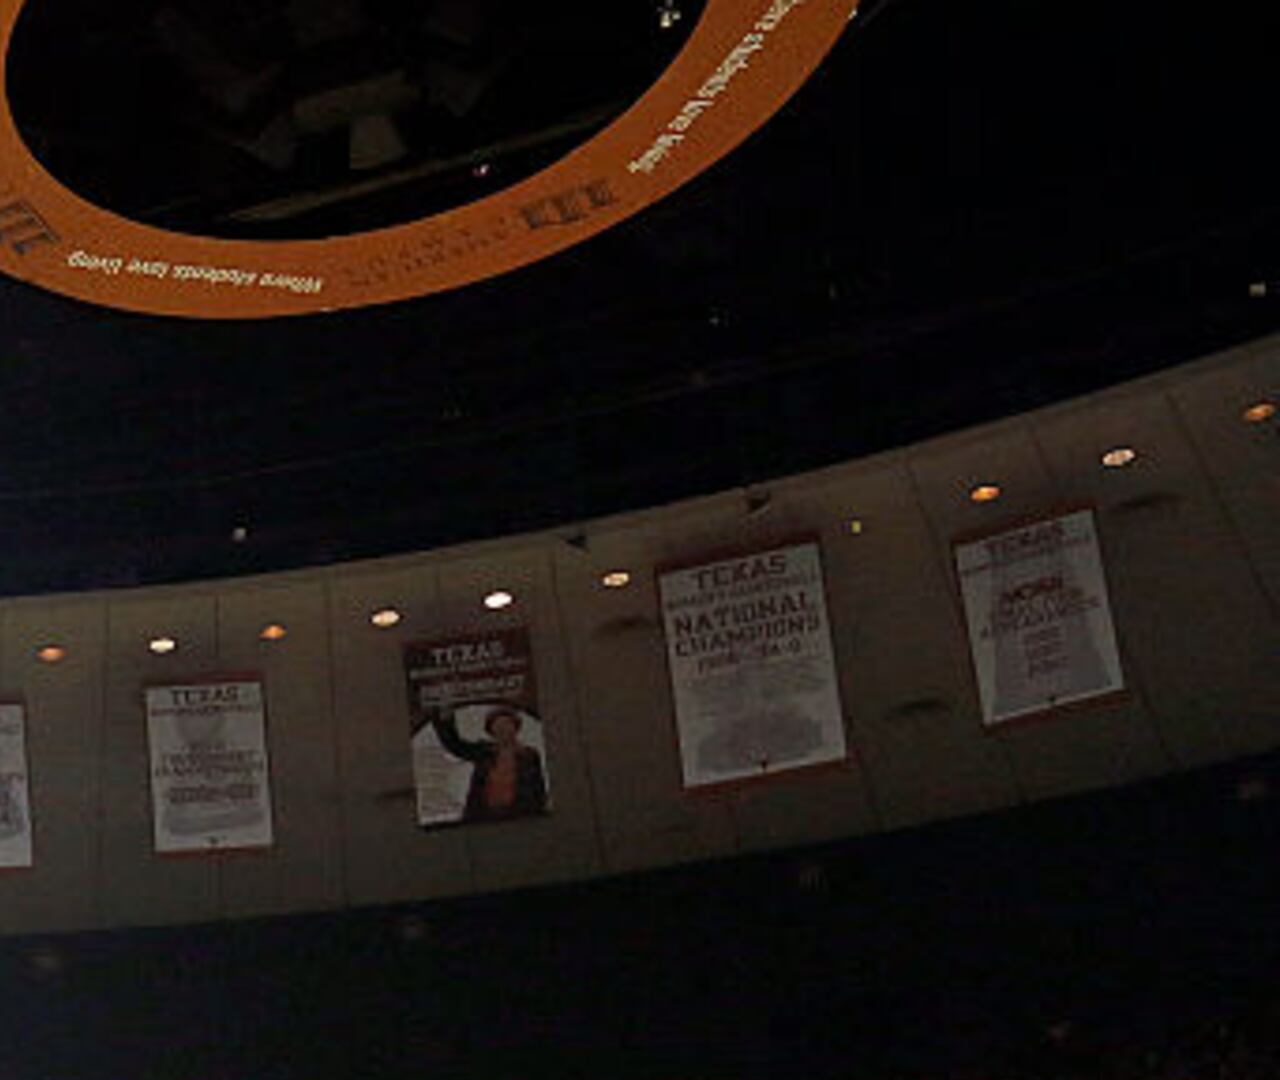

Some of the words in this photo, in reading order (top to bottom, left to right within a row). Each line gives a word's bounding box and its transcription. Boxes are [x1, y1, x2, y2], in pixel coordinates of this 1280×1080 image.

[693, 553, 787, 591] TEXAS
[673, 591, 809, 638] NATIONAL
[675, 613, 821, 658] CHAMPIONS
[169, 685, 240, 706] TEXAS
